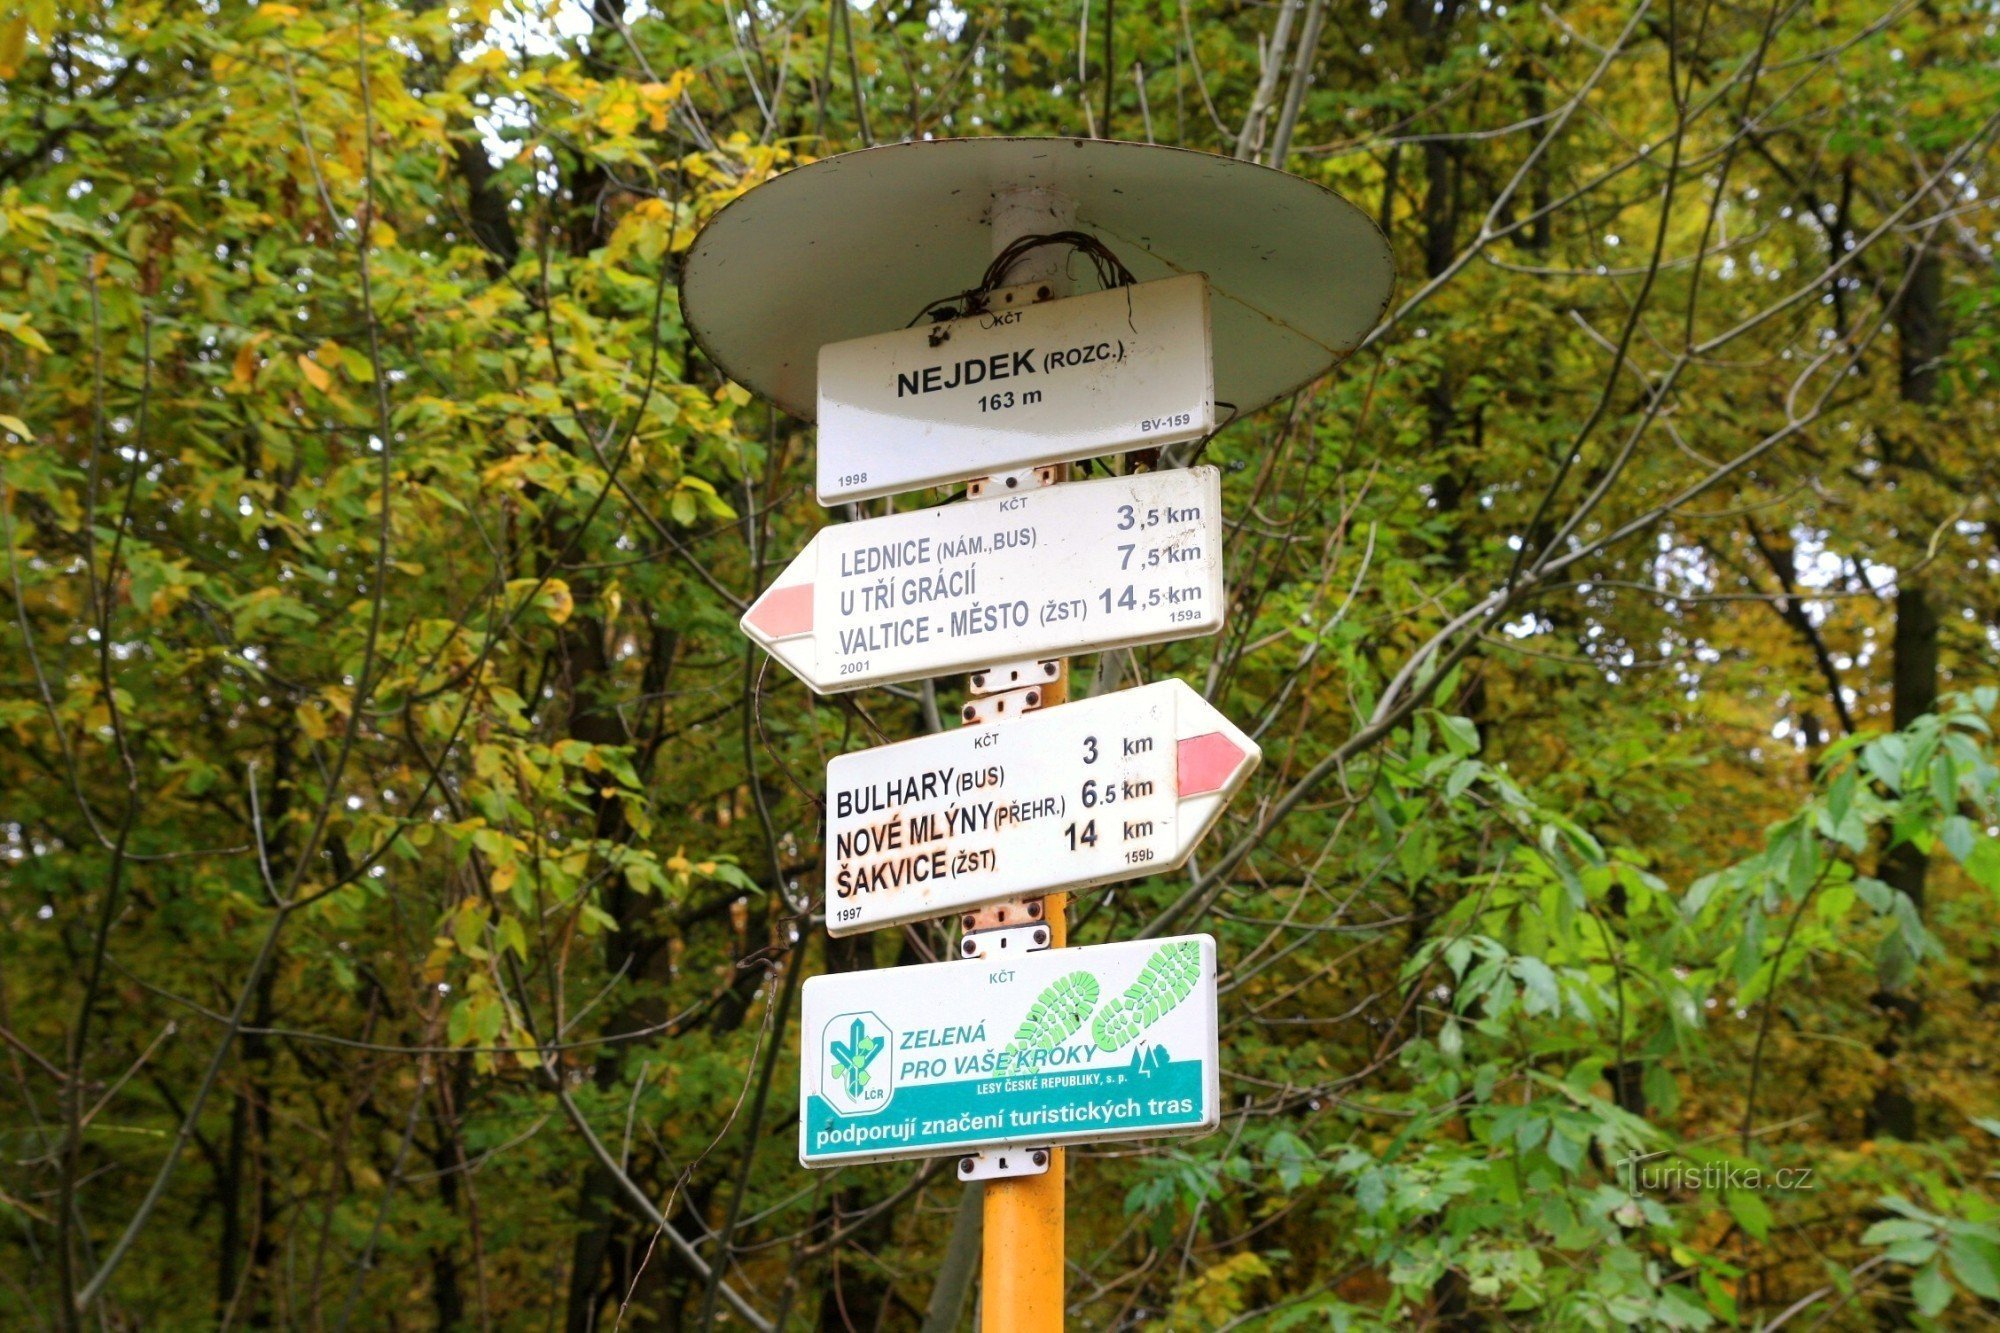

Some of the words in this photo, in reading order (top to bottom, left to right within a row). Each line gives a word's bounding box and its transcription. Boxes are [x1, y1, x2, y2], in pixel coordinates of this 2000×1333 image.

[994, 312, 1023, 327] KČT
[898, 348, 1035, 398] NEJDEK
[1043, 340, 1124, 374] (ROZC.)
[978, 391, 1014, 413] 163
[1023, 389, 1042, 405] m
[1141, 413, 1190, 433] BV-159
[838, 472, 868, 487] 1998
[1000, 497, 1028, 513] KČT
[841, 537, 930, 577] LEDNICE
[1117, 504, 1159, 532] 3,5
[1168, 505, 1201, 525] km
[841, 592, 854, 616] U
[862, 577, 895, 611] TŘÍ
[901, 562, 976, 606] GRÁCIÍ
[1117, 543, 1159, 571] 7,5
[1168, 545, 1201, 565] km
[840, 616, 929, 655] VALTICE
[951, 600, 1029, 640] MĚSTO
[1039, 598, 1087, 628] (ŽST)
[1098, 584, 1160, 615] 14,5
[1169, 584, 1202, 604] km
[1169, 609, 1202, 623] 159a
[840, 661, 870, 676] 2001
[974, 733, 999, 750] KČT
[837, 768, 955, 818] BULHARY
[1083, 735, 1099, 765] 3
[1123, 734, 1153, 756] km
[837, 815, 901, 860] NOVÉ
[909, 798, 993, 845] MLÝNY
[1123, 779, 1153, 800] km
[837, 850, 947, 899] ŠAKVICE
[951, 848, 996, 879] (ŽST)
[1064, 819, 1099, 852] 14
[1123, 819, 1154, 841] km
[1124, 848, 1154, 865] 159b
[837, 906, 862, 922] 1997
[989, 971, 1016, 985] KČT
[900, 1019, 986, 1050] ZELENÁ
[900, 1058, 947, 1080] PRO
[954, 1048, 1011, 1076] VAŠE
[1016, 1043, 1098, 1069] KROKY
[865, 1086, 884, 1101] LČR
[977, 1081, 1001, 1096] LESY
[1005, 1076, 1038, 1093] ČESKÉ
[1041, 1073, 1104, 1091] REPUBLIKY,
[816, 1117, 917, 1149] podporují
[922, 1112, 1003, 1136] značení
[1010, 1097, 1142, 1131] turistických
[1148, 1096, 1193, 1117] tras
